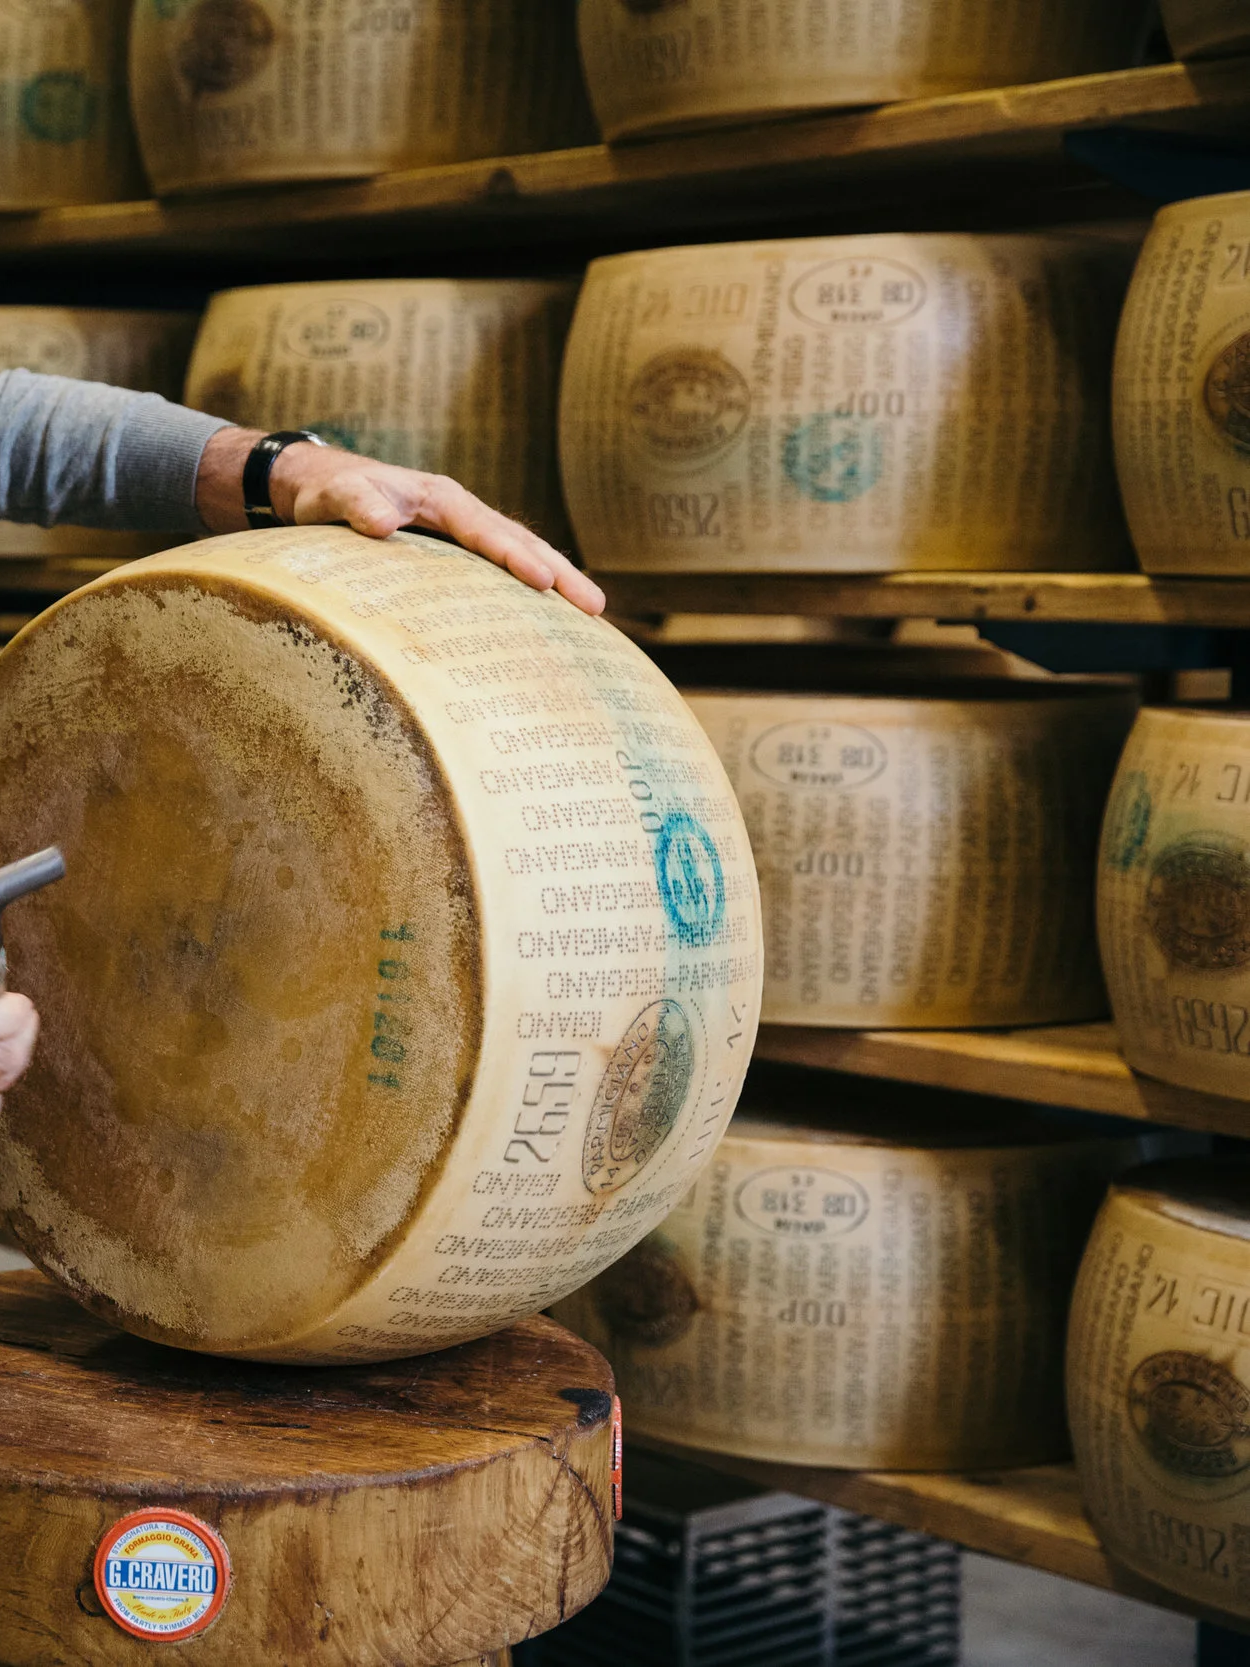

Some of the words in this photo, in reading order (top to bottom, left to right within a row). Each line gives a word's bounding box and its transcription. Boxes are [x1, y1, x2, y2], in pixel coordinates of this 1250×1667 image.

[489, 721, 614, 755] REGGIANO
[615, 750, 664, 834] DOP
[504, 839, 657, 875] PARMIGIANO
[795, 850, 866, 878] DOP
[541, 880, 664, 915] REGGIANO
[517, 923, 667, 959] PARMIGIANO
[547, 966, 667, 999] REGGIANO
[502, 1049, 582, 1164] 2659
[481, 1201, 607, 1230] REGGIANO
[434, 1233, 587, 1260] PARMIGIANO
[437, 1263, 564, 1287] REGGIANO
[776, 1299, 847, 1328] DOP
[112, 1523, 160, 1555] STAGIONATURA
[166, 1523, 212, 1560] ESPORTAZIONE
[124, 1533, 172, 1555] FORMAGGIO
[173, 1537, 199, 1559] GRANA
[108, 1560, 214, 1593] G.CRAVERO
[113, 1597, 130, 1618] FROM
[130, 1615, 157, 1630] PARTLY
[159, 1617, 193, 1631] SKIMMED
[194, 1604, 209, 1620] MILK
[127, 1603, 157, 1619] Made
[169, 1605, 192, 1619] Italy
